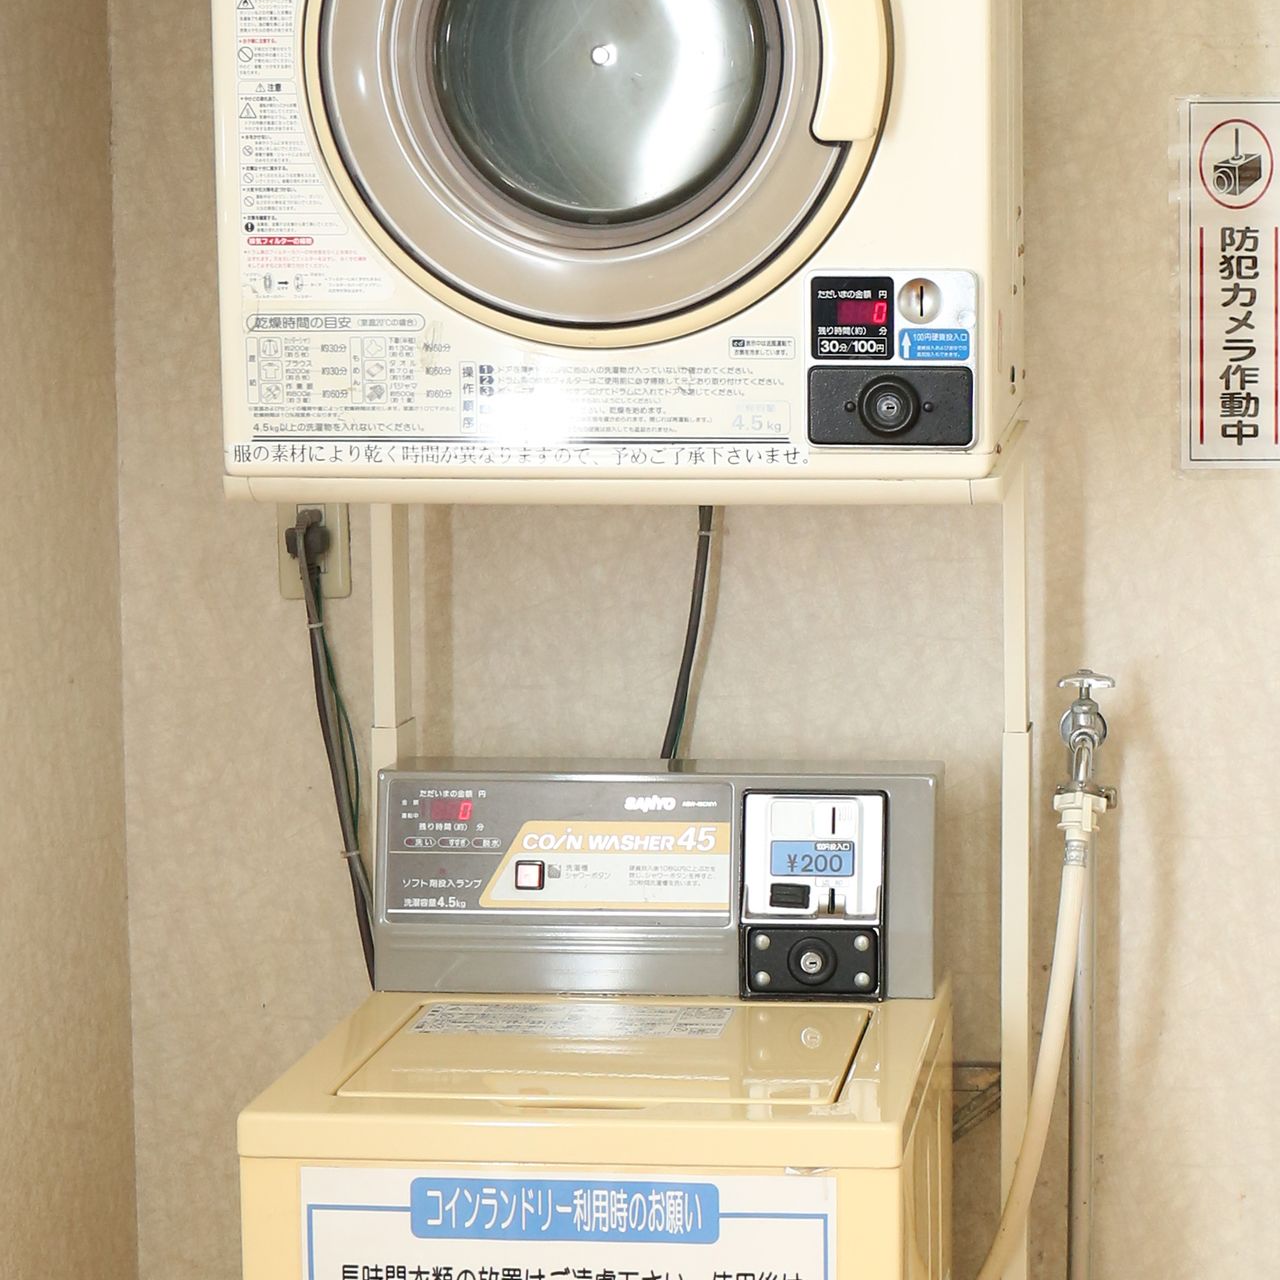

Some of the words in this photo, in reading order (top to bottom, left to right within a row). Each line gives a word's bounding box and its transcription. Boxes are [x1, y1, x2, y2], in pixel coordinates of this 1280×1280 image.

[878, 290, 888, 299] 円
[873, 302, 887, 324] 0
[254, 316, 351, 330] 乾燥時間の目安
[878, 327, 888, 336] 分
[1218, 225, 1260, 447] 防犯カメラ作動中
[820, 340, 885, 353] 30分/100円
[478, 790, 487, 798] 円
[624, 794, 676, 813] SANYO
[458, 801, 473, 820] 0
[475, 823, 485, 832] 分
[588, 834, 677, 851] WASHER
[677, 826, 717, 851] 45
[787, 854, 843, 873] ¥200
[425, 1186, 703, 1235] コインランドリー利用時のお願い
